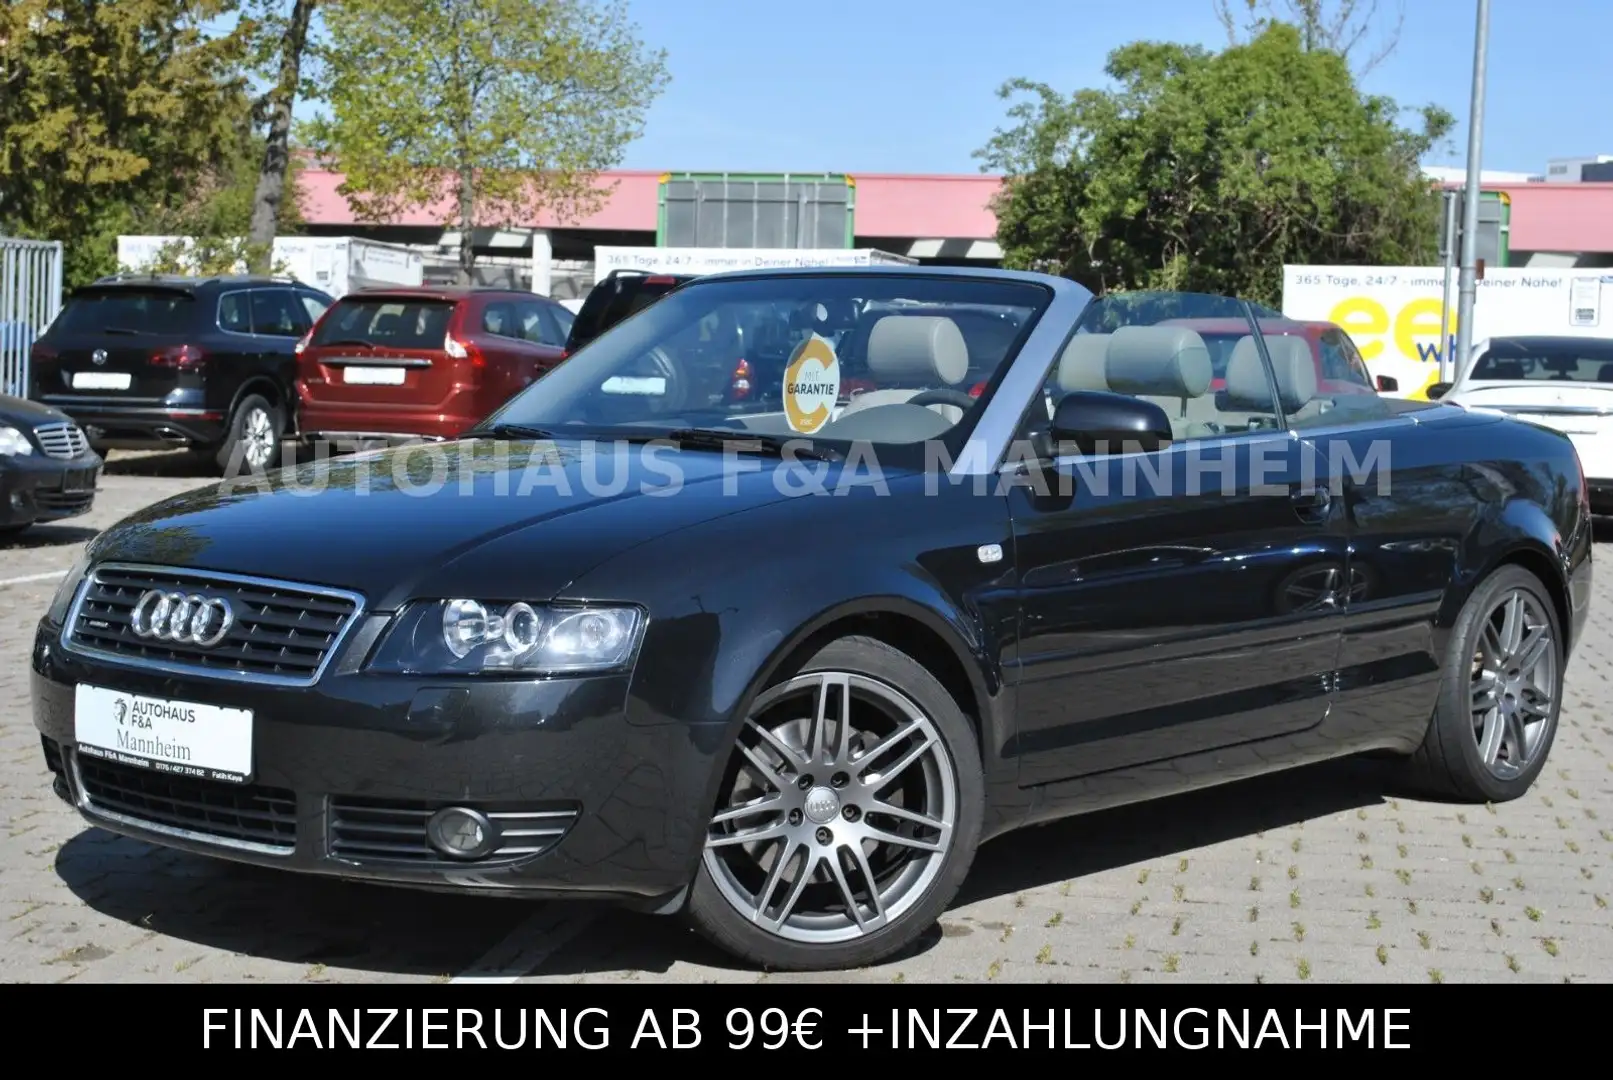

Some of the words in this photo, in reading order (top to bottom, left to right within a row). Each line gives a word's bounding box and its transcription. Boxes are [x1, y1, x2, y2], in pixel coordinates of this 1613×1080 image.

[1296, 275, 1321, 285] 365
[1365, 275, 1398, 286] 24/7
[787, 383, 835, 396] GARANTIE
[131, 701, 196, 723] AUTOHAUS
[131, 715, 153, 730] F&A
[116, 728, 192, 761] Mannheim
